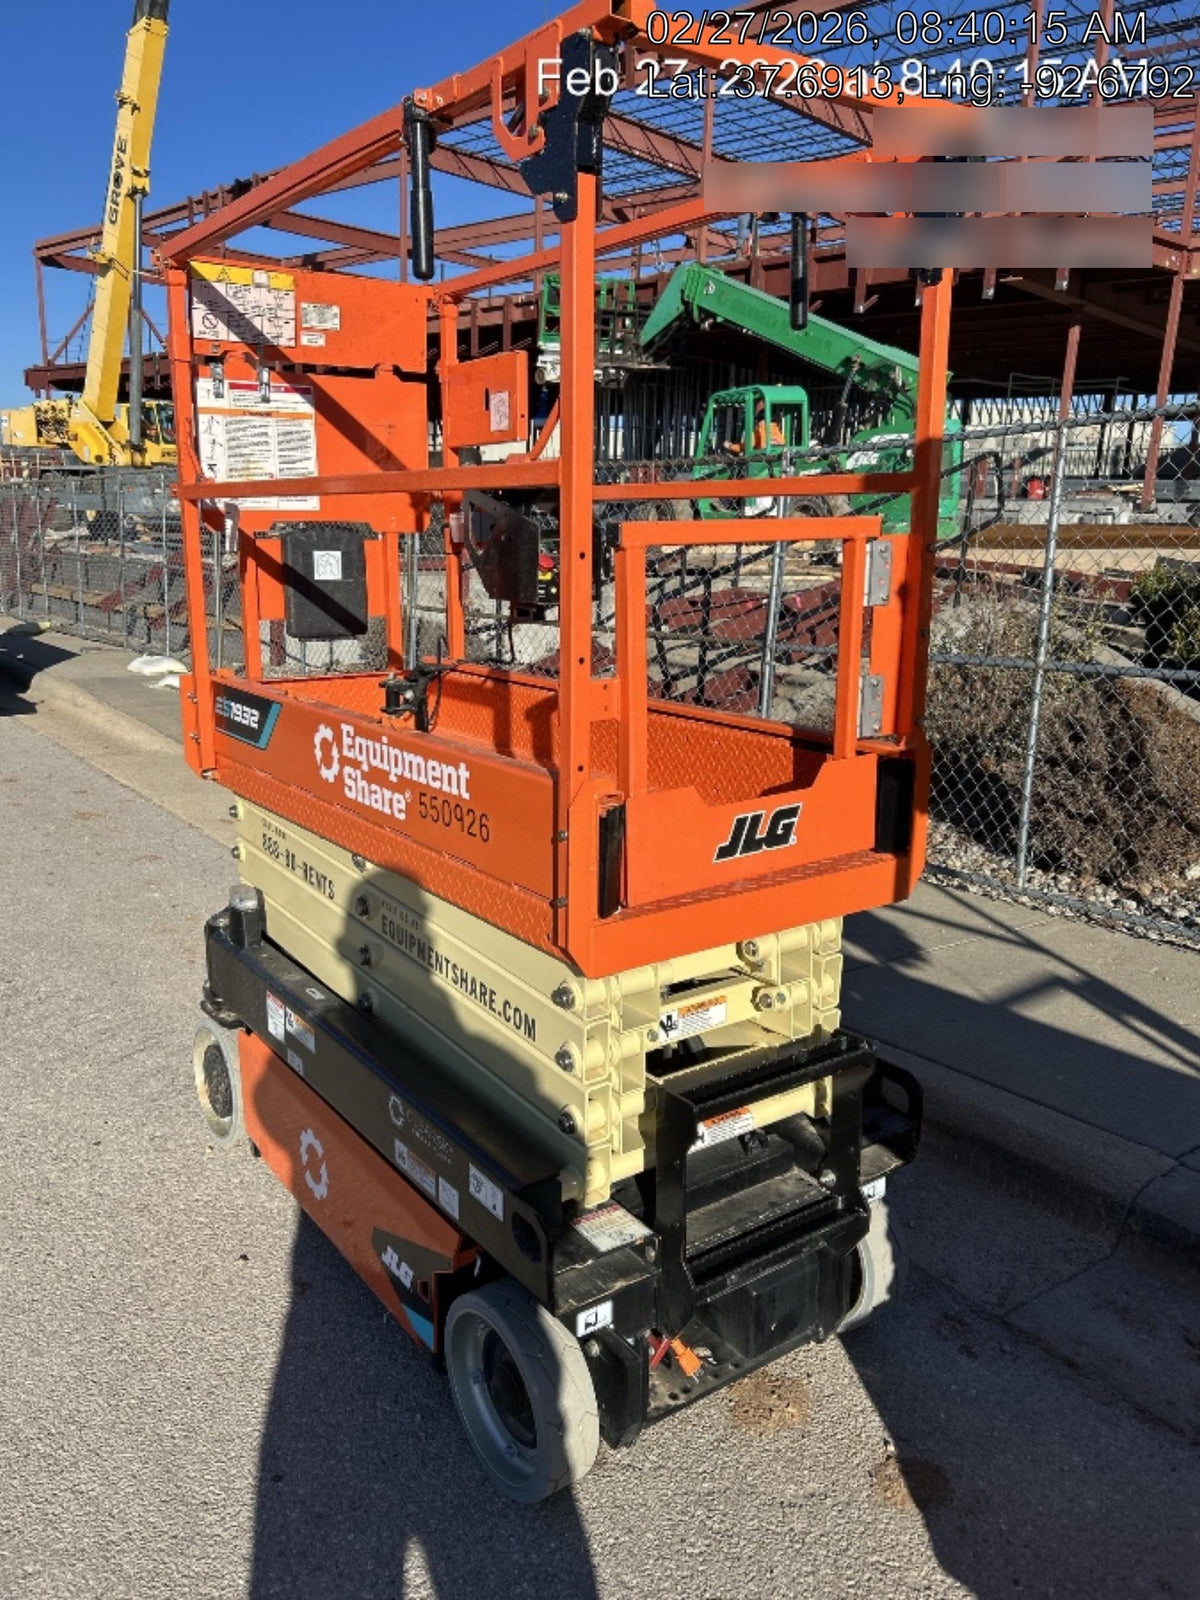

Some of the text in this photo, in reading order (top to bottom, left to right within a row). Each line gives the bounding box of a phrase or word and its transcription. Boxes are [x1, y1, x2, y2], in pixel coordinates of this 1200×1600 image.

[107, 135, 128, 226] GROVE
[340, 723, 470, 800] Equipment
[418, 791, 490, 843] 550926
[713, 803, 803, 863] JLG
[381, 914, 537, 1042] EQUIPMENTSHARE.COM
